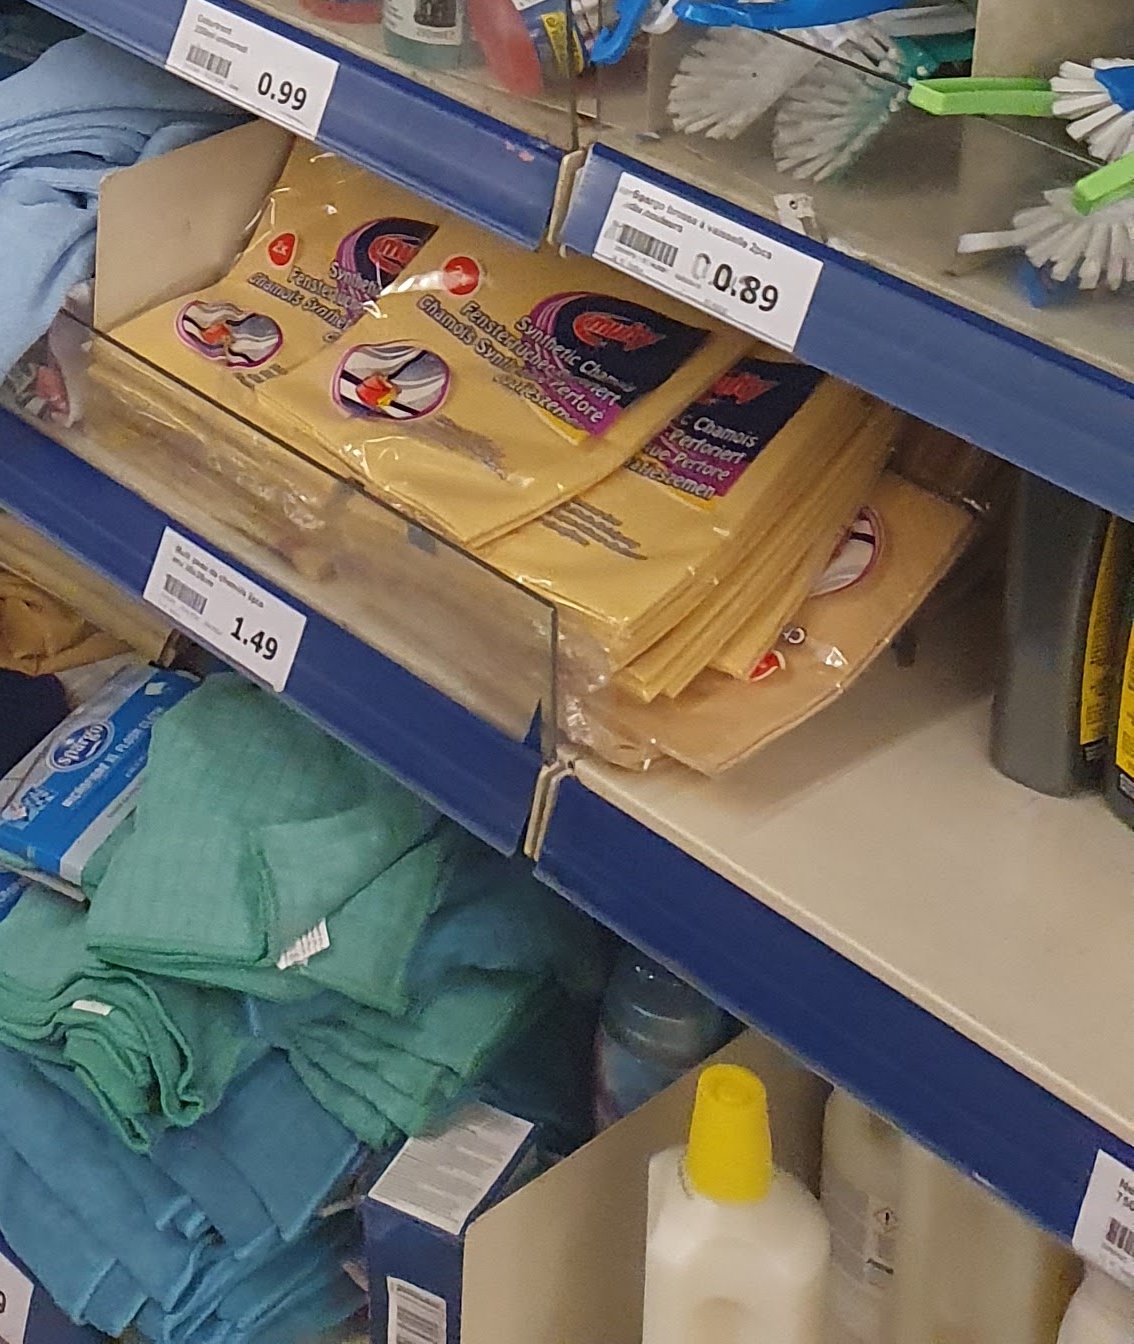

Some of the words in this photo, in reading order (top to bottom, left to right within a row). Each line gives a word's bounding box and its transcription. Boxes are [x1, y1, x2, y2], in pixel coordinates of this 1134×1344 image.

[257, 72, 307, 111] 0.99
[713, 263, 778, 312] 0.89
[416, 293, 477, 346] Chamois
[694, 416, 758, 448] Chamois
[230, 616, 278, 661] 1.49
[58, 725, 105, 766] spargo
